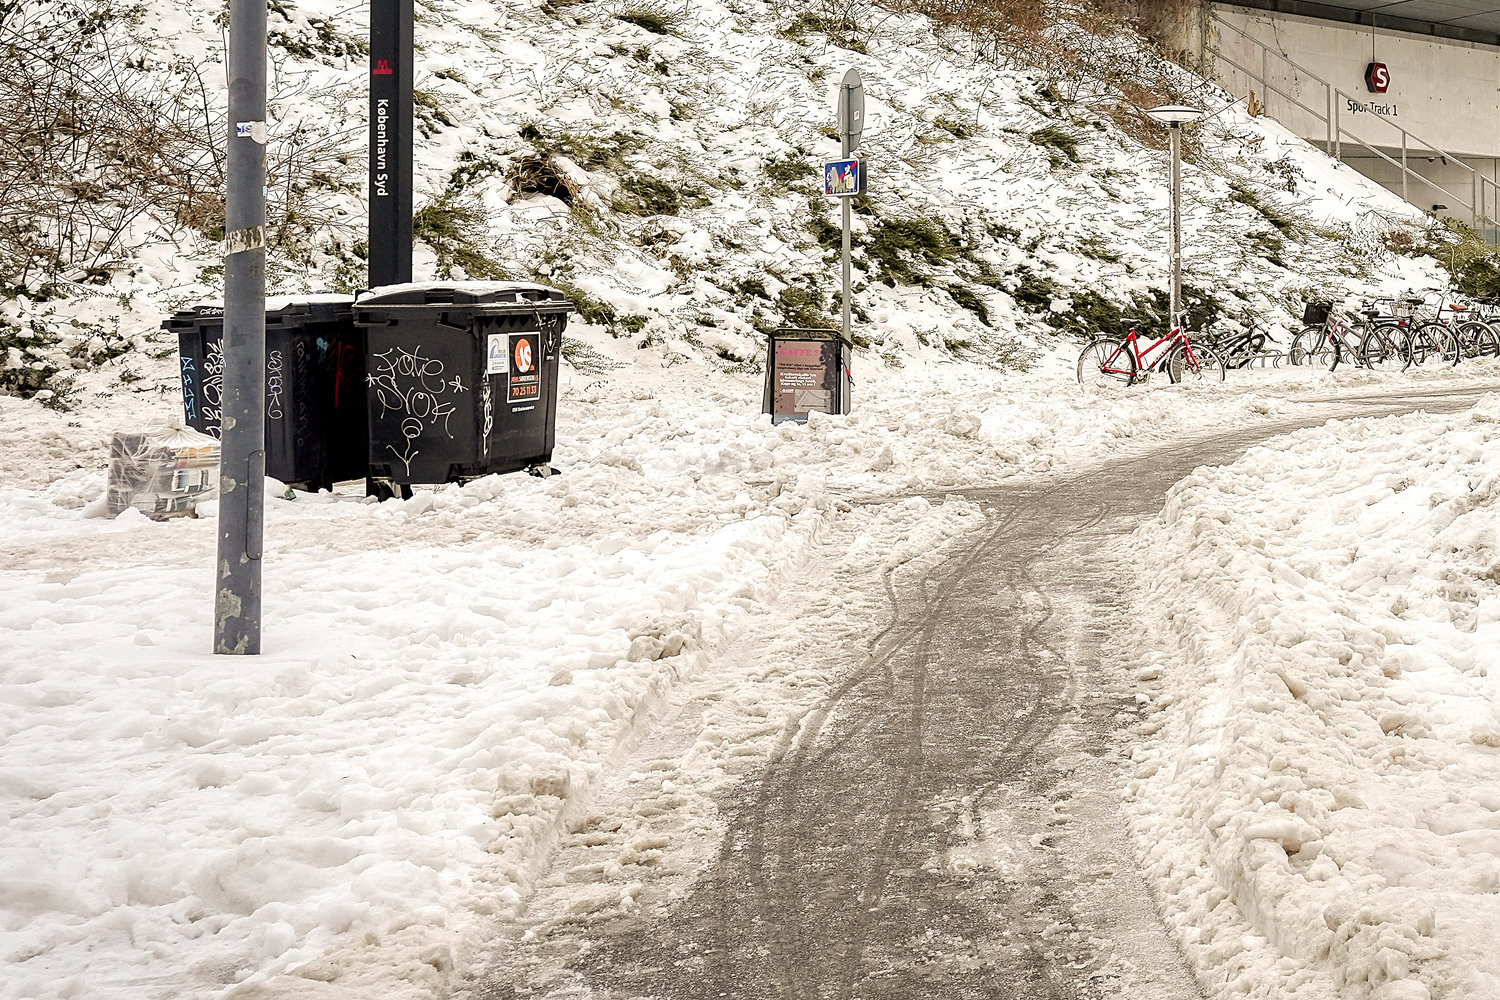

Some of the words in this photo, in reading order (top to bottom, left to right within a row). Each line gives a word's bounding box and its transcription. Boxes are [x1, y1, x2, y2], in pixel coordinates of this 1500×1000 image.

[1376, 68, 1387, 87] S
[1369, 101, 1391, 116] Track
[1393, 105, 1398, 116] 1
[376, 99, 390, 170] København
[374, 173, 389, 196] Syd
[779, 348, 811, 357] KAFFE
[513, 387, 519, 396] 70
